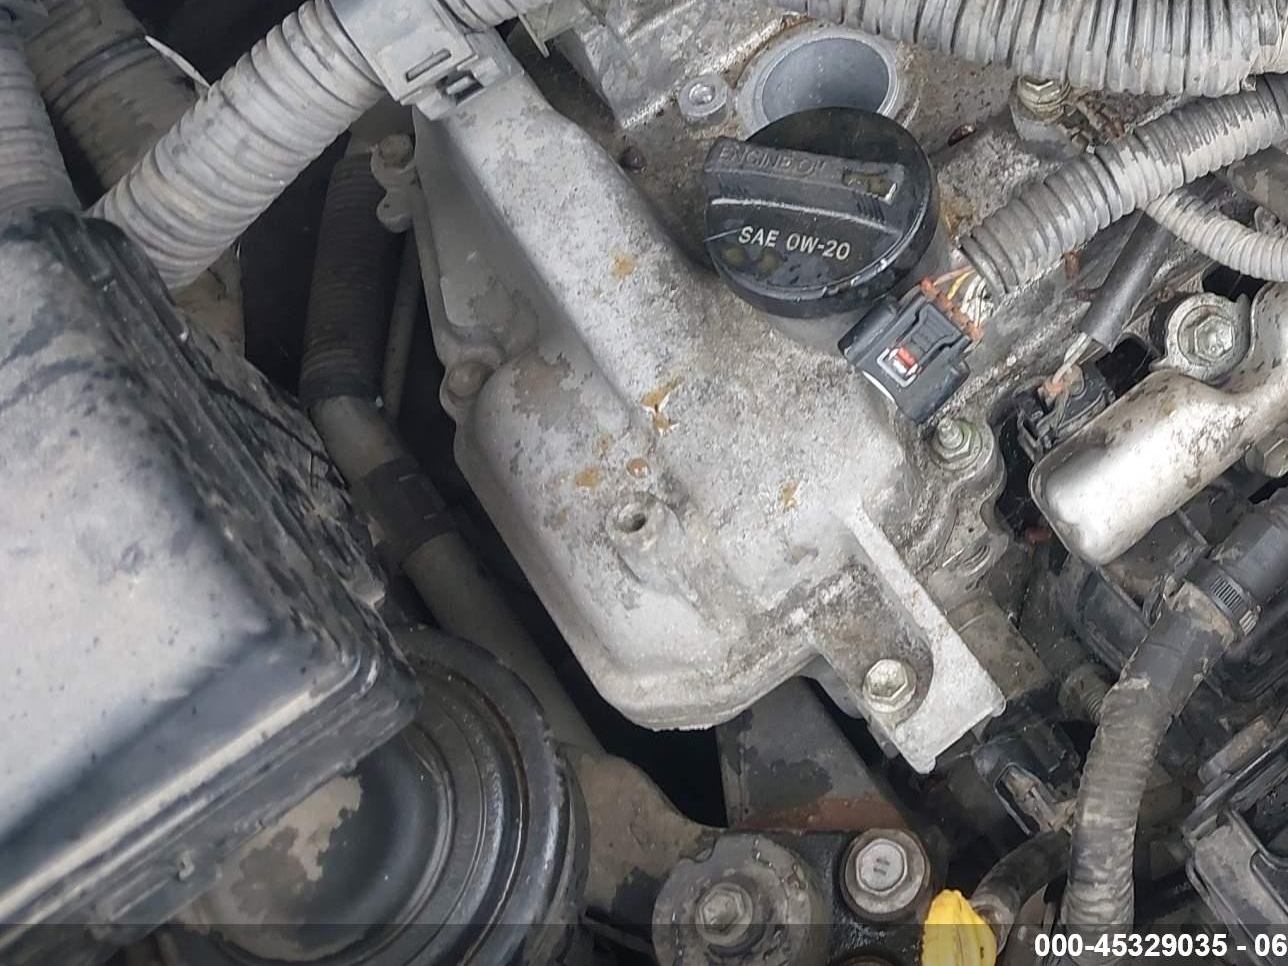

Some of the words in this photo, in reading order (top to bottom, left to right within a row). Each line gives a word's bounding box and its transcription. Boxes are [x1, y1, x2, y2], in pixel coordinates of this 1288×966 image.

[719, 147, 794, 172] ENGINE
[738, 225, 780, 249] SAE
[786, 234, 851, 261] 0W-20
